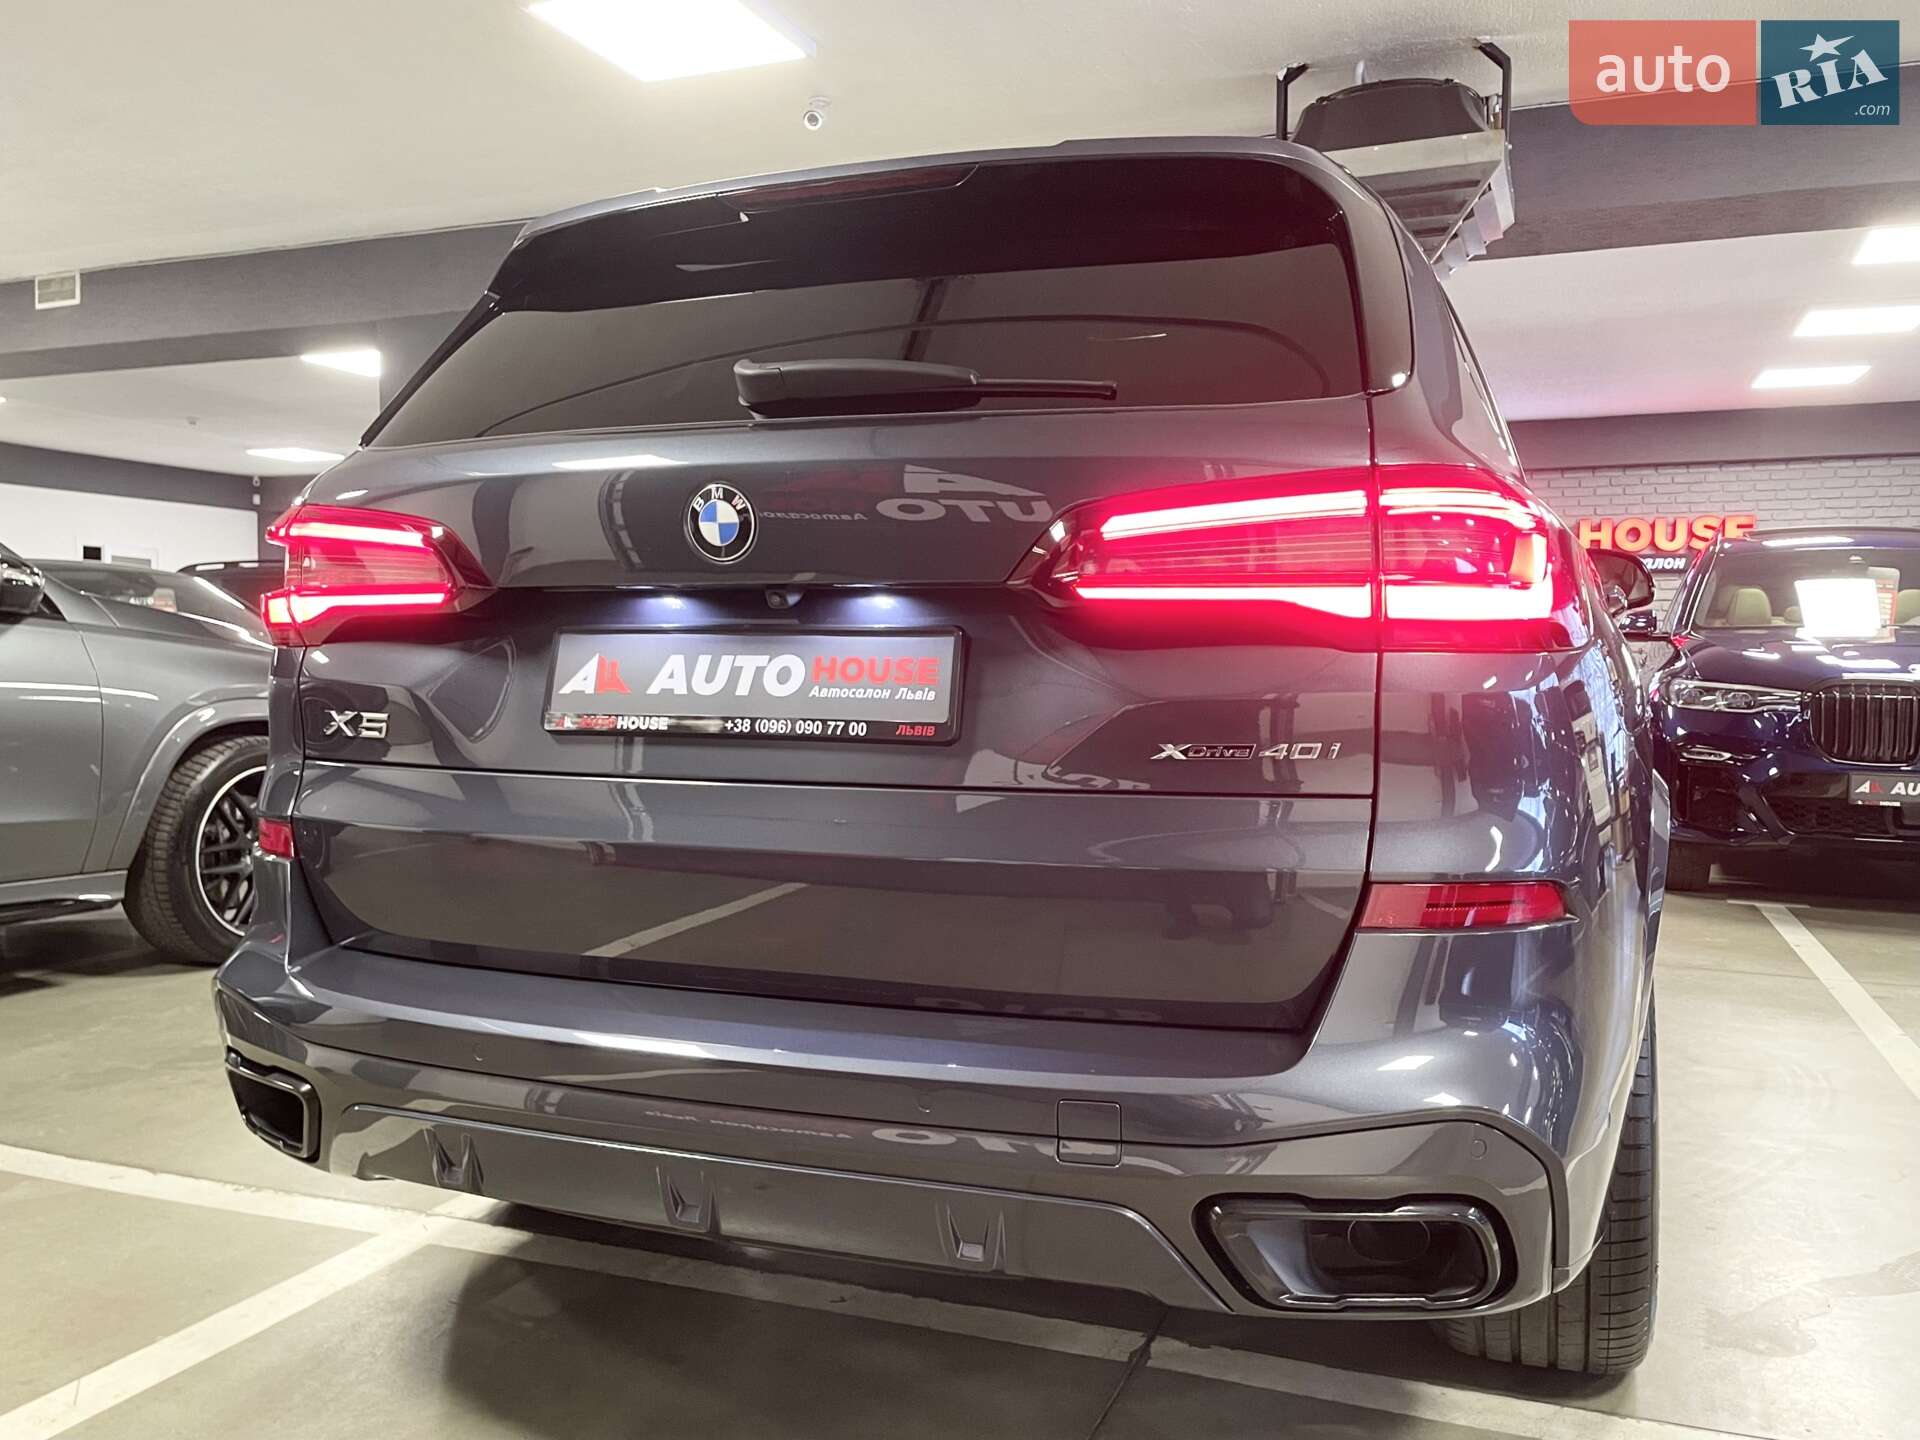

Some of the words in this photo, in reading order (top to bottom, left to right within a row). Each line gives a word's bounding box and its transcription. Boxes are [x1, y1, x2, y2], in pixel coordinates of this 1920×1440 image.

[692, 487, 746, 513] BMW
[1577, 514, 1757, 552] HOUSE
[645, 654, 806, 697] AUTO
[811, 655, 941, 686] HOUSE
[808, 685, 892, 700] Автосалон
[894, 687, 936, 702] Львів
[322, 709, 390, 739] X5
[617, 715, 669, 731] HOUSE
[724, 718, 751, 733] +38
[755, 719, 792, 734] (096)
[795, 720, 822, 735] 090
[826, 721, 845, 736] 77
[848, 722, 867, 736] 00
